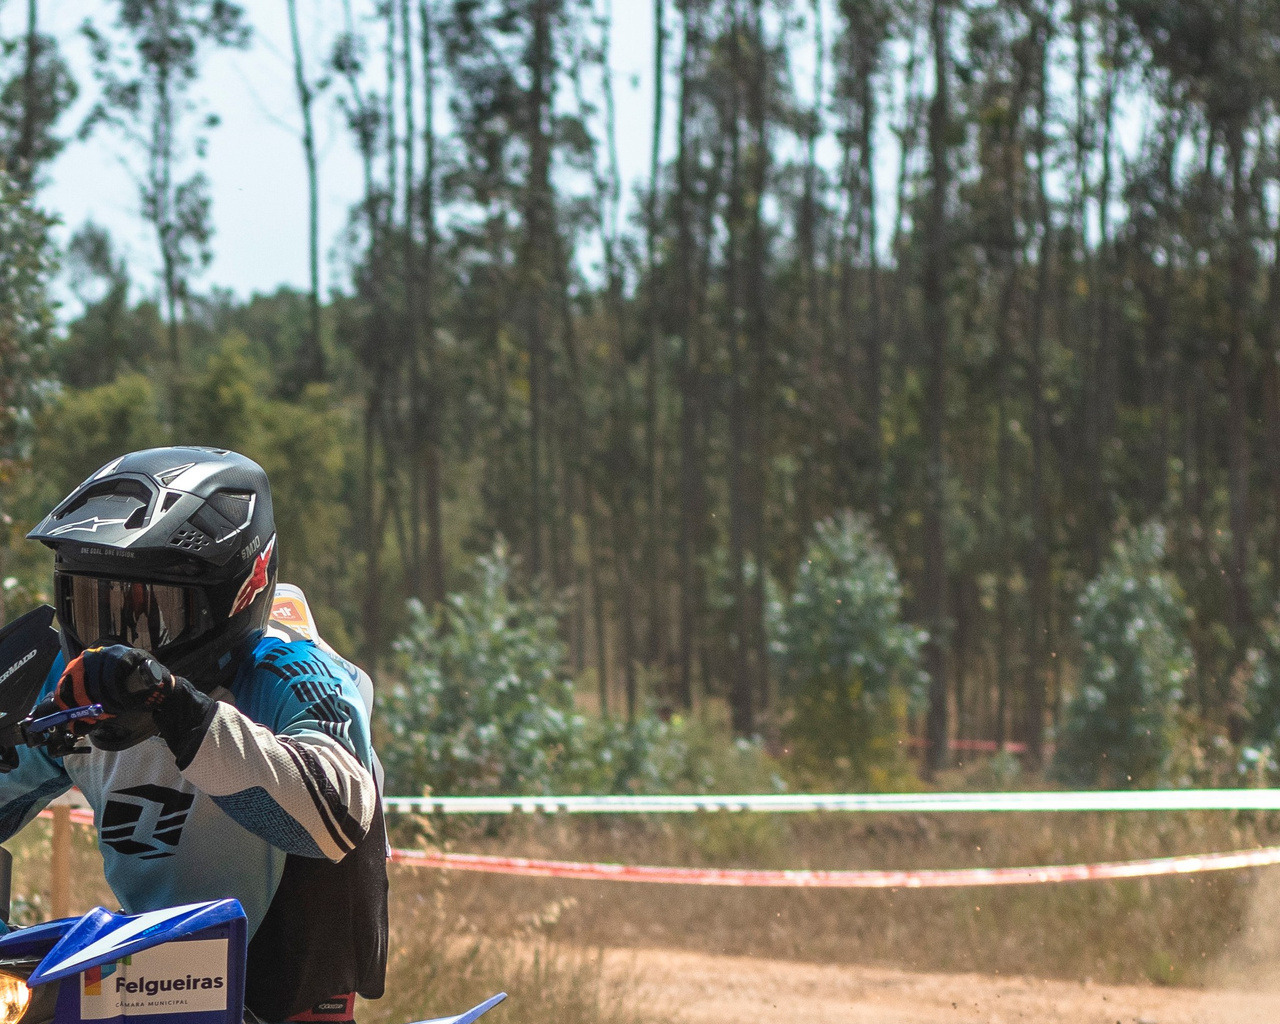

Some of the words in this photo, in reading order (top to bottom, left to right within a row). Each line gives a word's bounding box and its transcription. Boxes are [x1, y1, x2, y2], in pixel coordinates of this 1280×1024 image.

[115, 974, 224, 996] Felgueiras
[115, 1000, 146, 1008] CÂMARA
[147, 999, 188, 1007] MUNICIPAL
